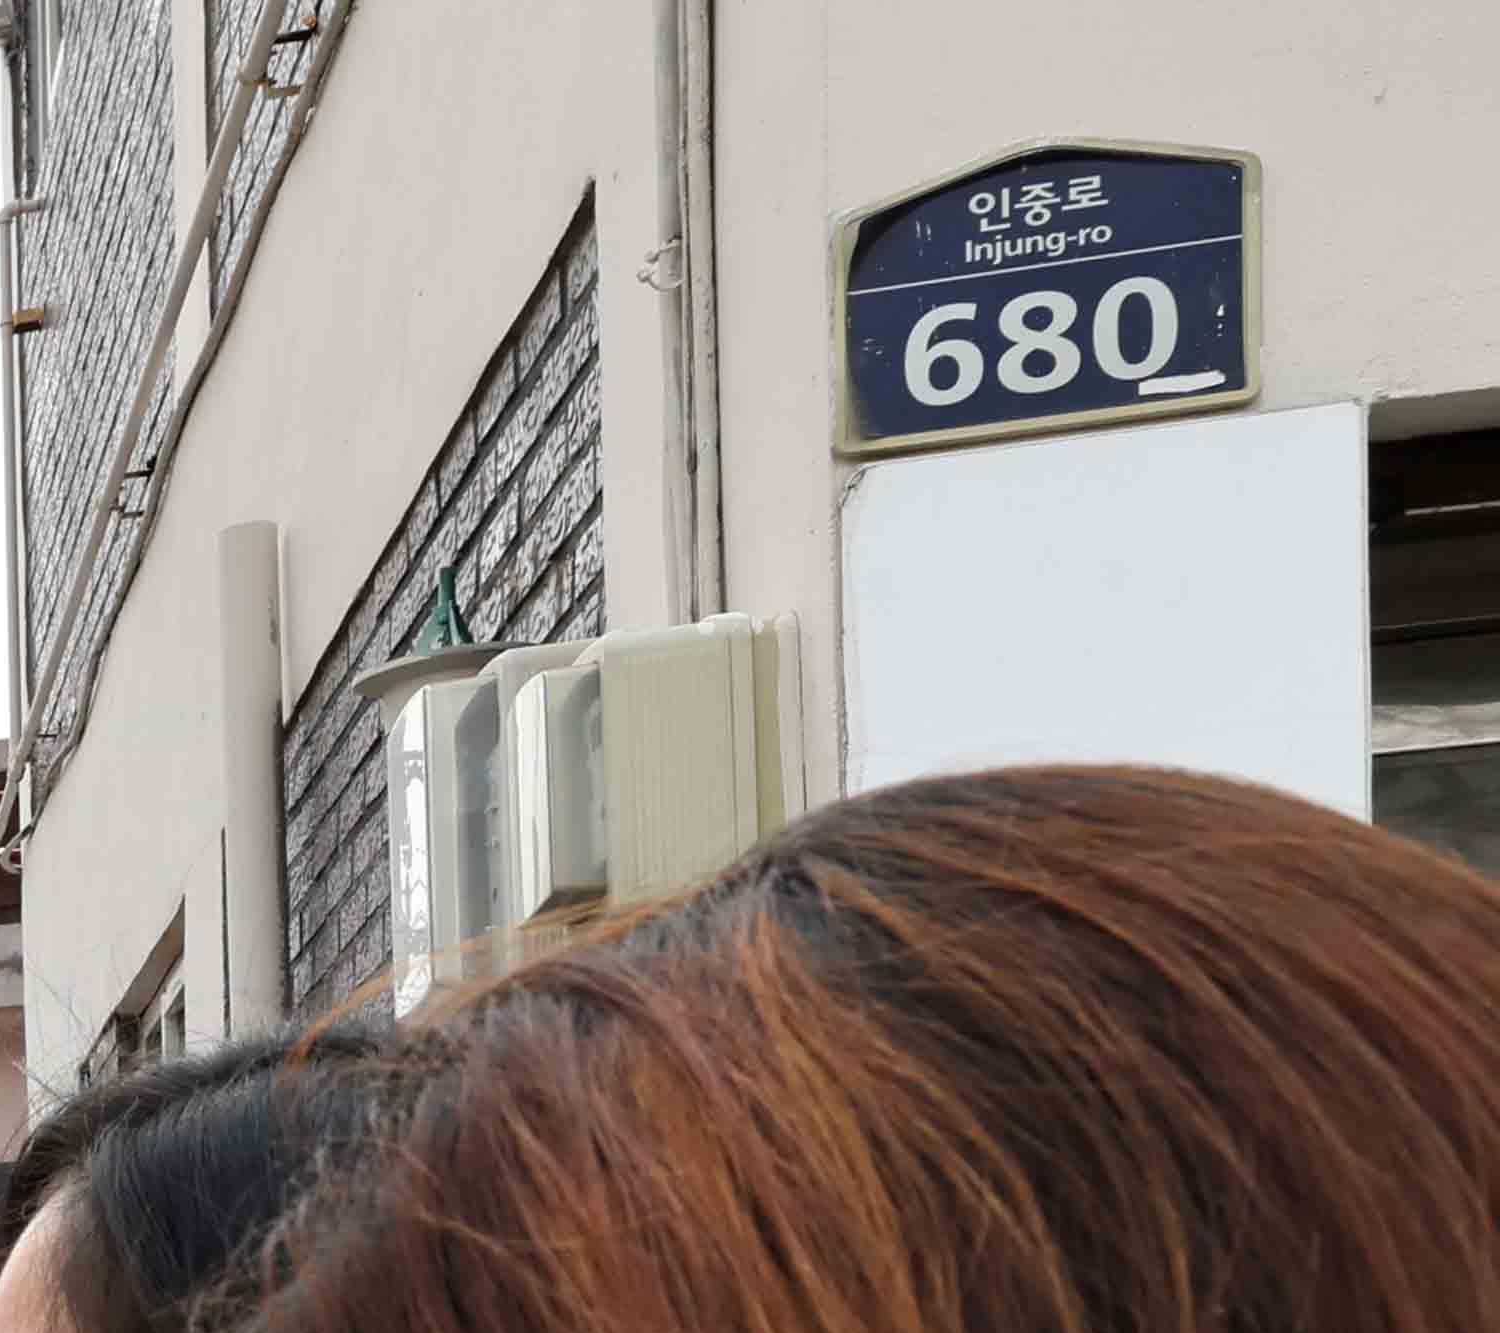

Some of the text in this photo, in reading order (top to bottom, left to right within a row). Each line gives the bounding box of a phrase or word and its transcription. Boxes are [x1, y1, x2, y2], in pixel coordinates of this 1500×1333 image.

[969, 175, 1109, 233] 인중로
[965, 225, 1113, 265] Injung-ro
[903, 276, 1180, 407] 680
